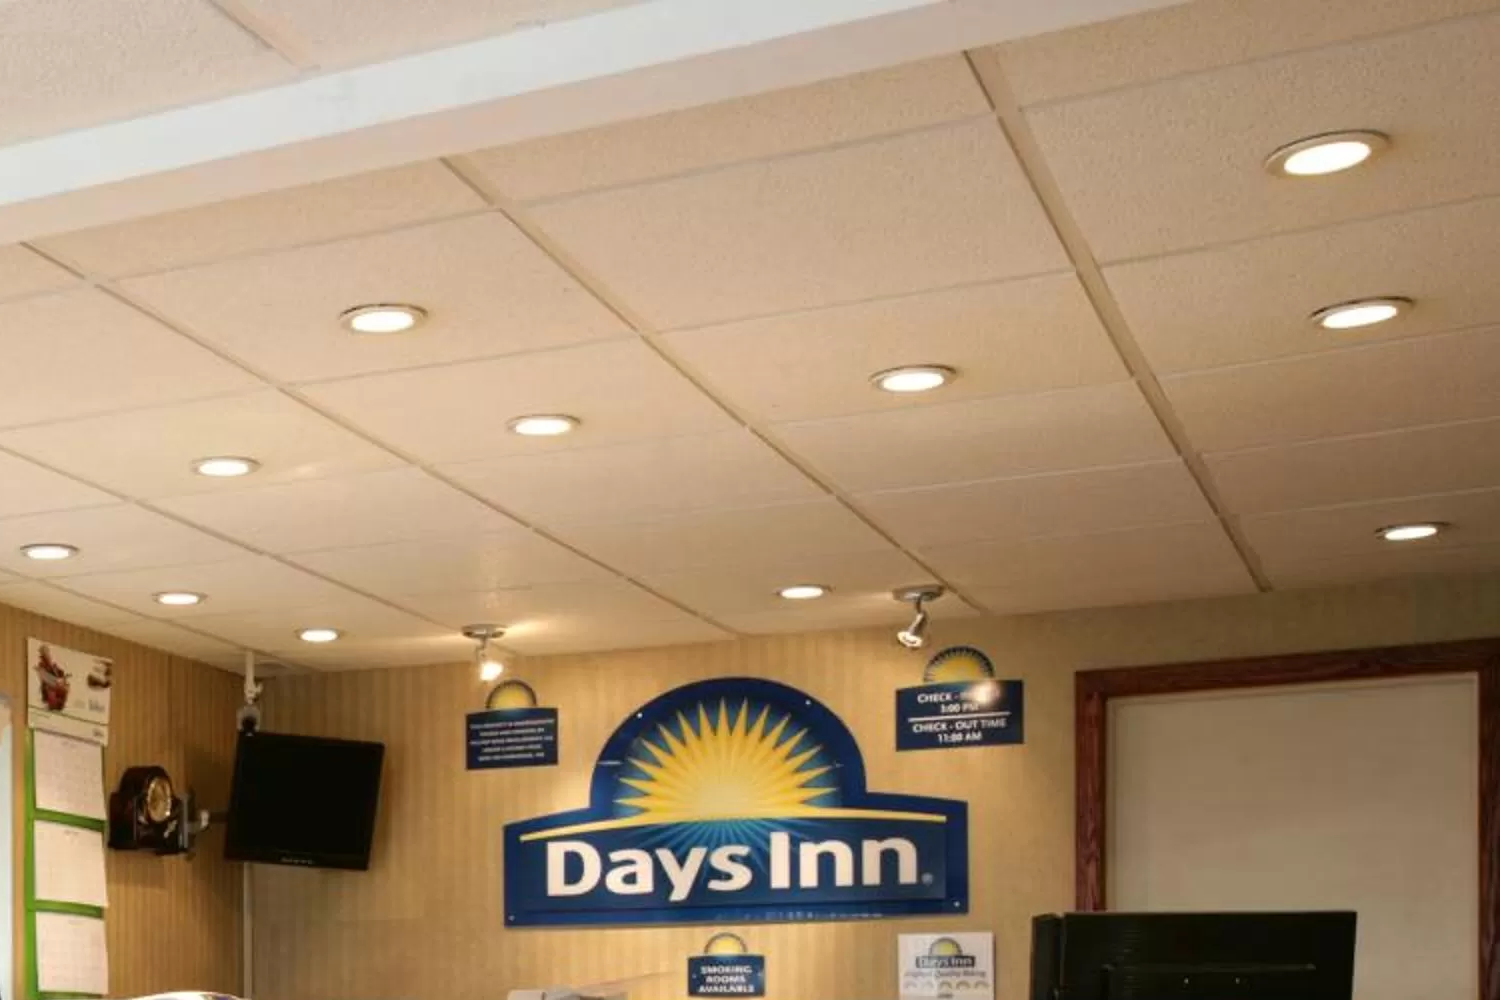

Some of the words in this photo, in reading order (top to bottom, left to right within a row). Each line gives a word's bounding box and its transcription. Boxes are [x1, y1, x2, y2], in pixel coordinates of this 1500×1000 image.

[917, 692, 952, 704] CHECK
[912, 721, 948, 733] CHECK
[955, 719, 978, 731] OUT
[981, 718, 1007, 729] TIME
[965, 731, 983, 742] AM
[546, 840, 754, 902] Days
[769, 831, 918, 890] Inn
